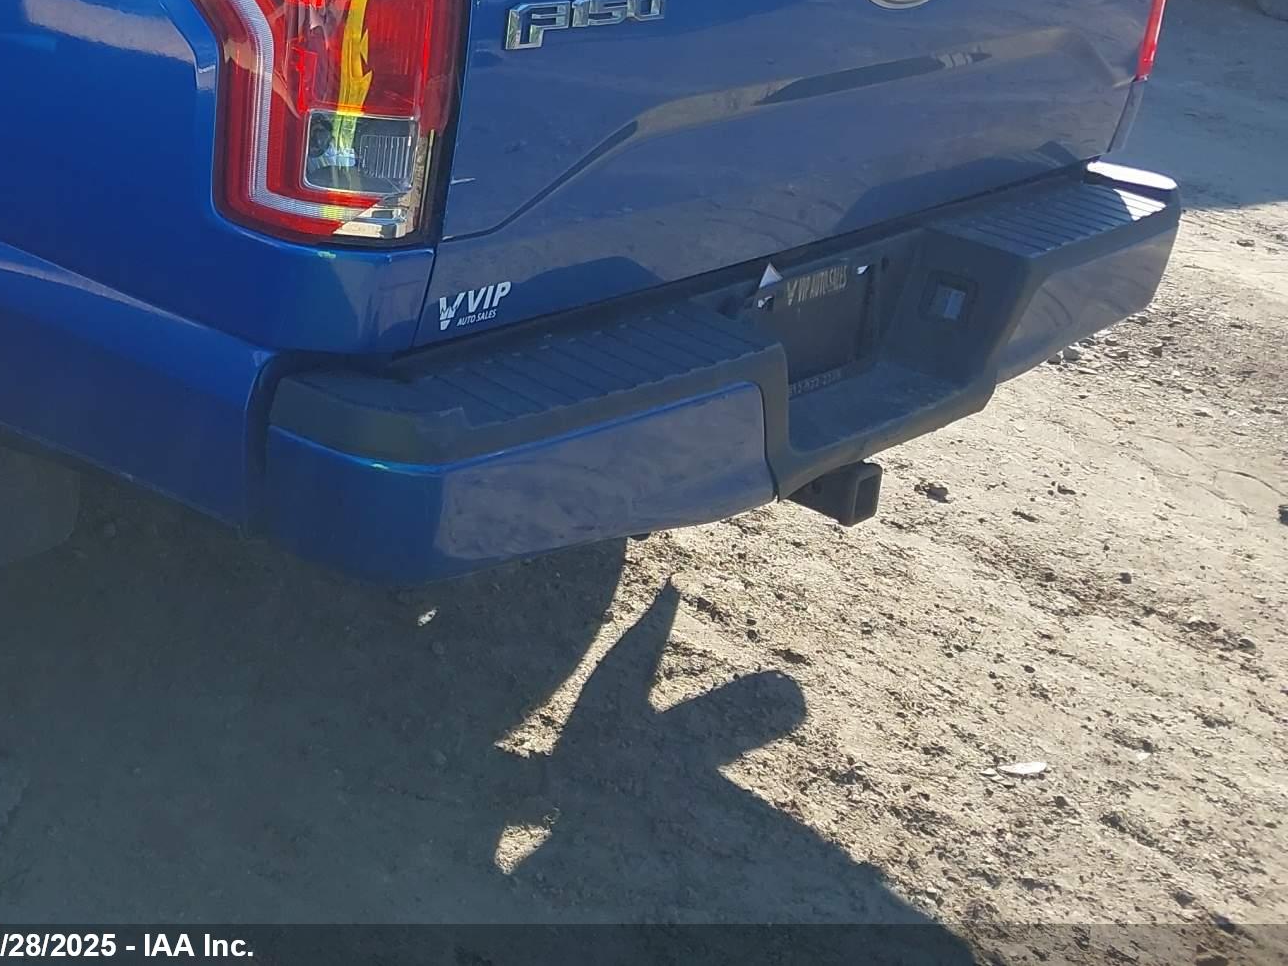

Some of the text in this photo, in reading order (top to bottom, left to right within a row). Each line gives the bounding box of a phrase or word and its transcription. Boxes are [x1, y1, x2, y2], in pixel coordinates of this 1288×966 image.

[468, 281, 512, 313] VIP
[456, 309, 497, 327] AUTO SALES
